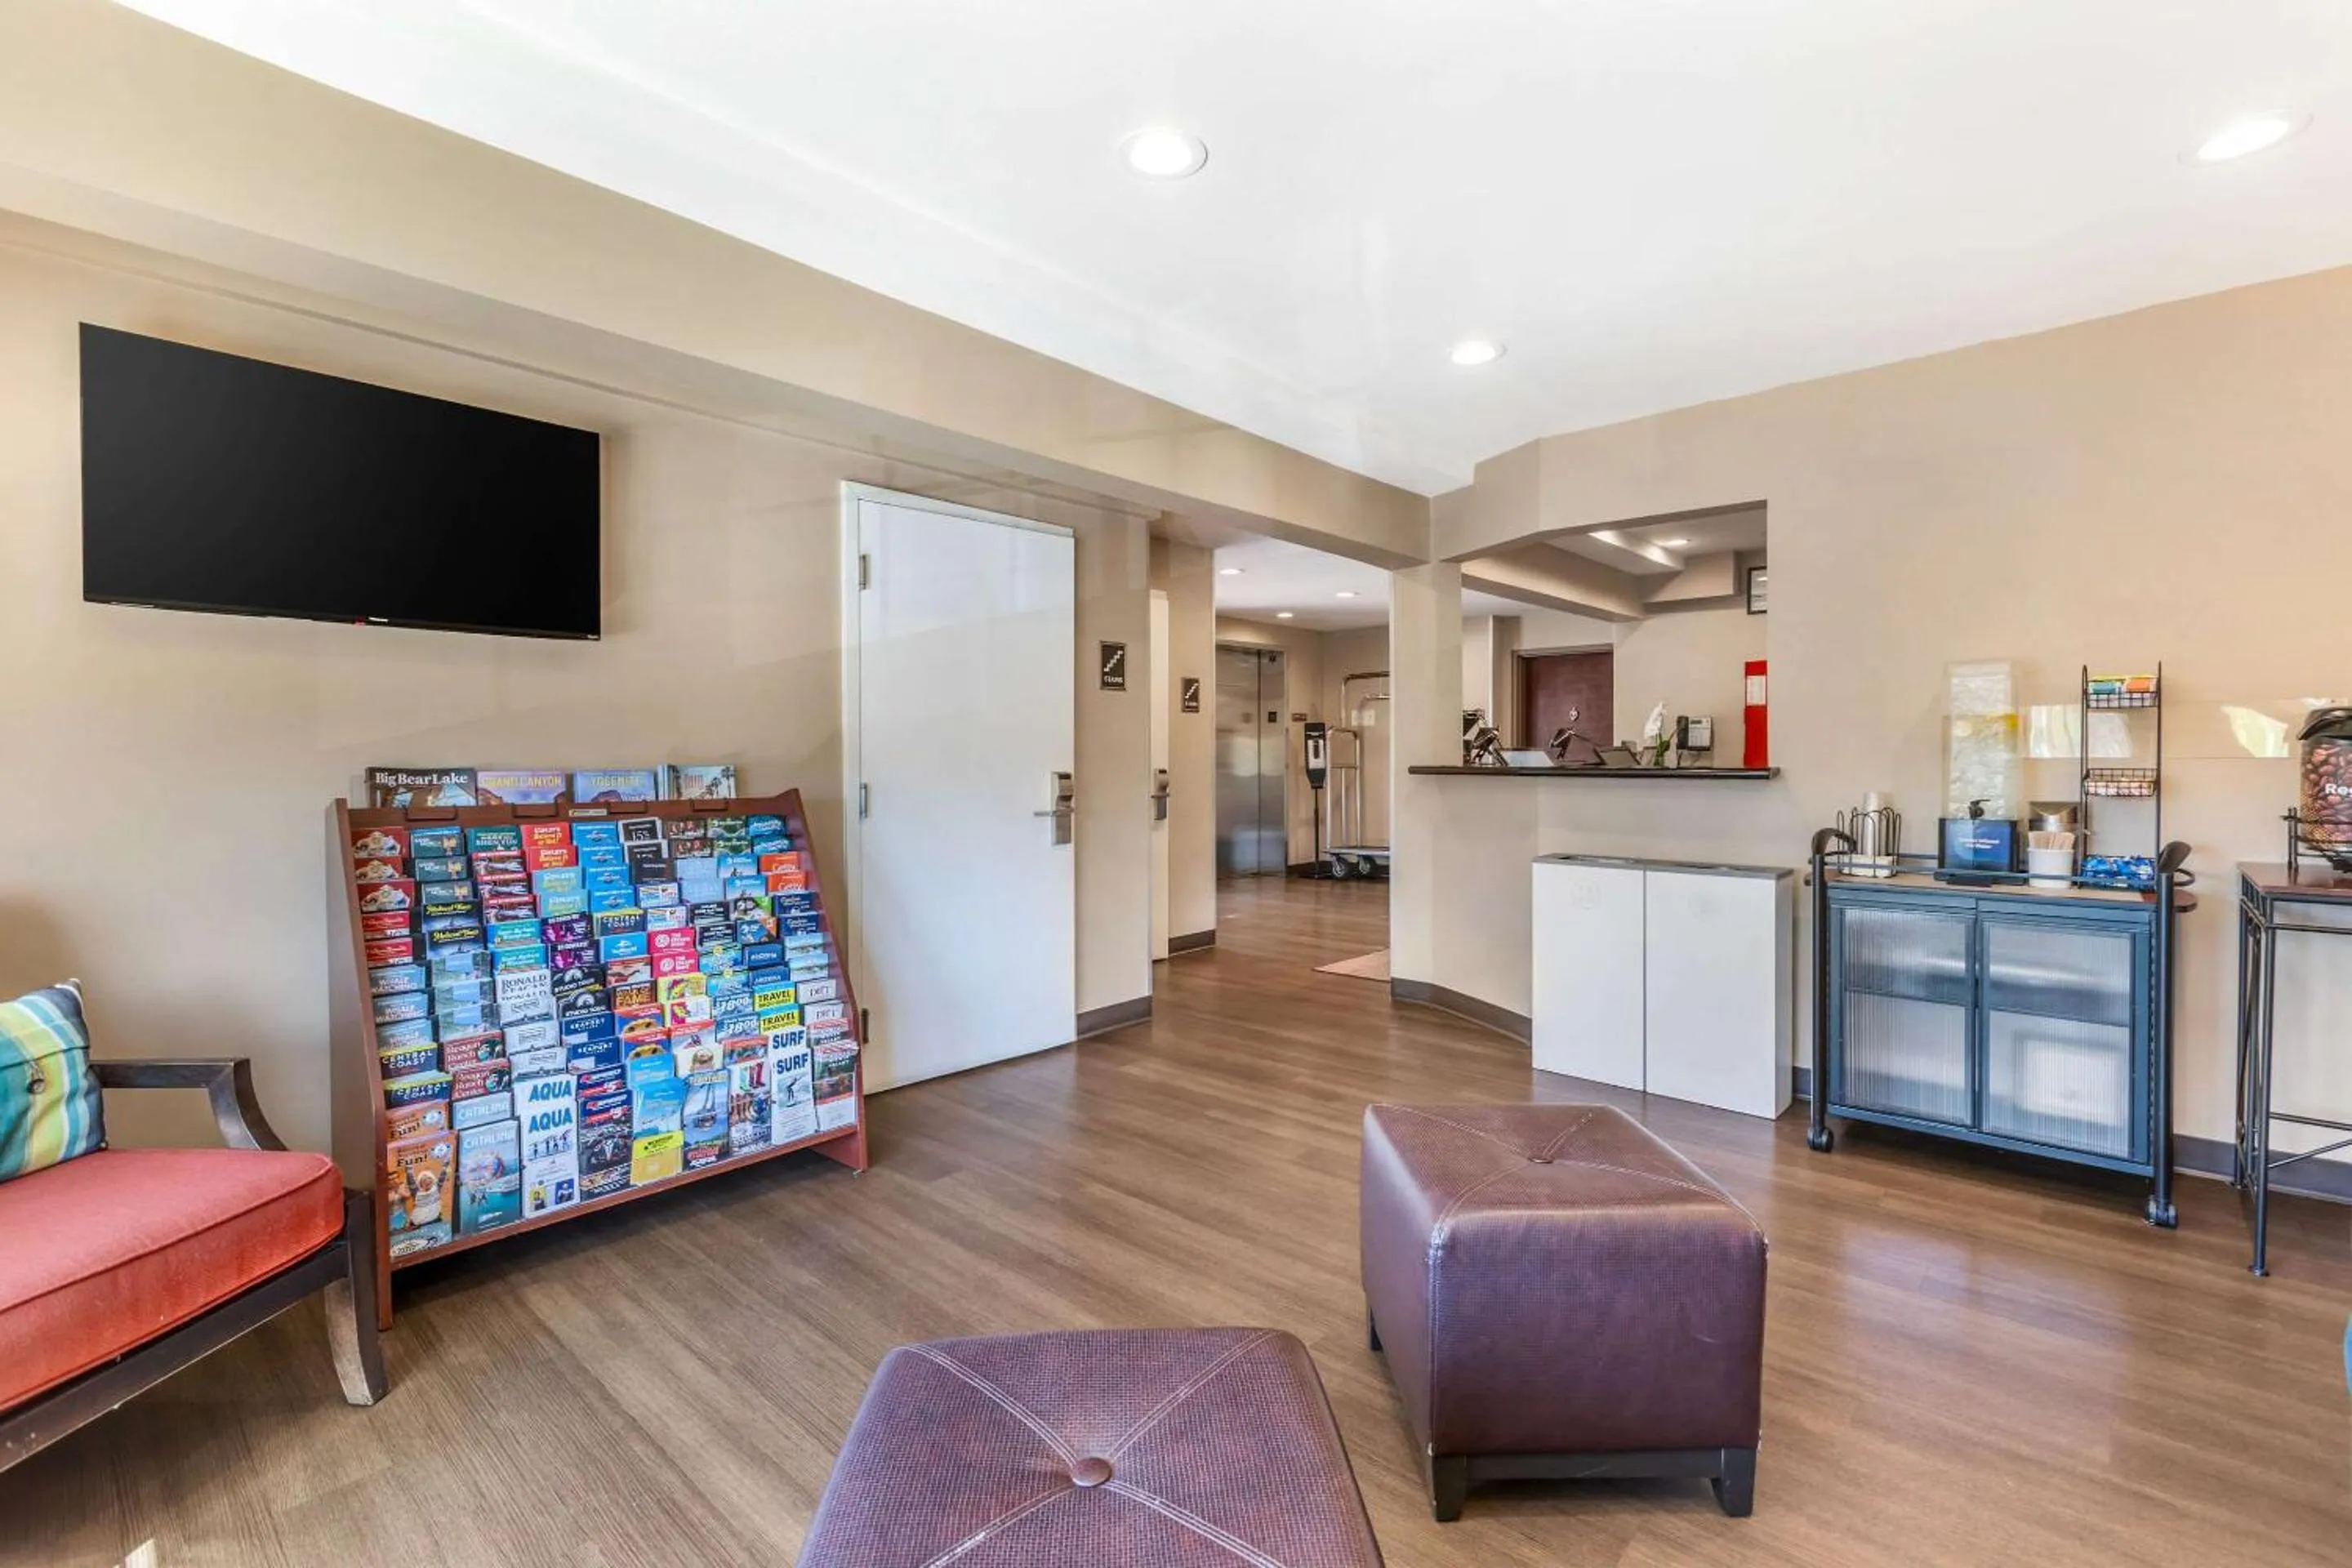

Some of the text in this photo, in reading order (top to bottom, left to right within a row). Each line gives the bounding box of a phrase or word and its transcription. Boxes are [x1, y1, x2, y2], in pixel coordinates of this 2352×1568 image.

[375, 772, 469, 786] Big Bear Lake
[502, 974, 546, 989] RONALD
[758, 991, 791, 1002] TRAVEL
[762, 1012, 795, 1026] TRAVEL
[773, 1030, 805, 1049] SURF
[382, 1049, 433, 1064] CENTRAL
[390, 1058, 425, 1069] COAST
[777, 1053, 808, 1074] SURF
[397, 1082, 448, 1095] CENTRAL
[404, 1089, 439, 1100] COAST
[528, 1080, 572, 1102] AQUA
[528, 1107, 572, 1134] AQUA
[390, 1123, 421, 1138] Fun!
[397, 1154, 428, 1167] Fun!
